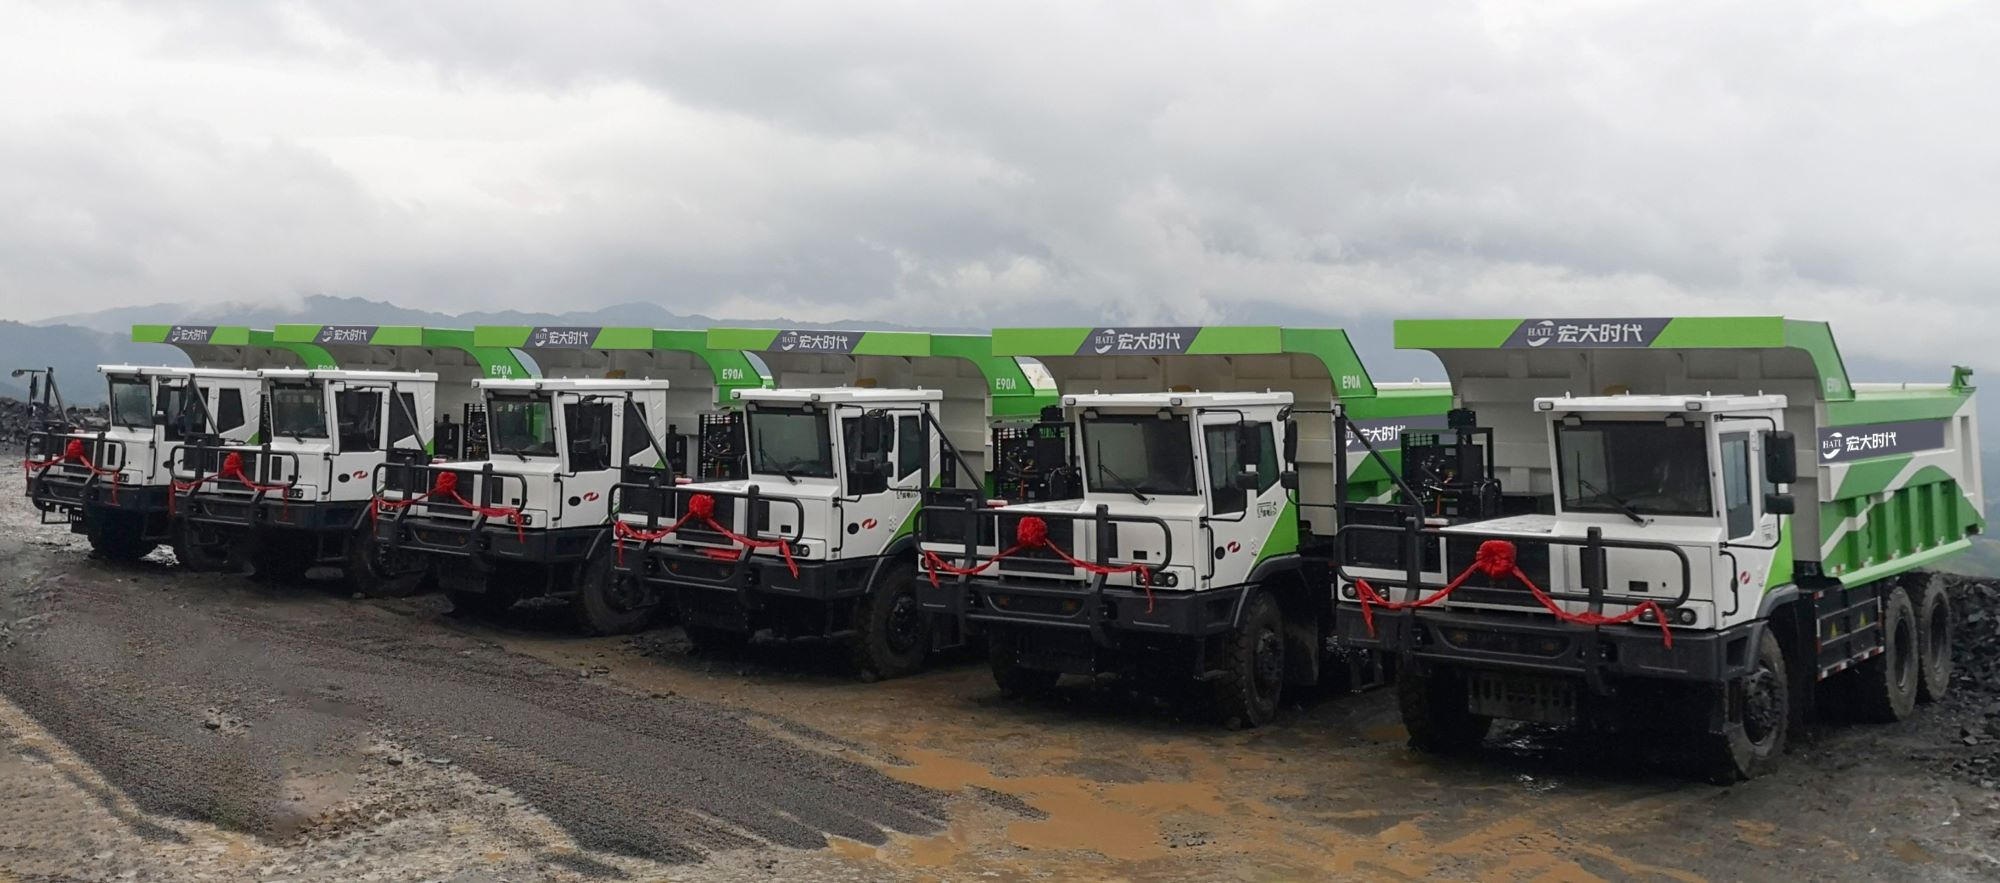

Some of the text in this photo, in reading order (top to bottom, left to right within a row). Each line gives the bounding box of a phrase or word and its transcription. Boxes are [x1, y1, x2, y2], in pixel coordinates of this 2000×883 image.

[334, 329, 367, 341] 宏大时代
[549, 331, 589, 345] 宏大时代
[1527, 324, 1643, 343] HATL 宏大时代
[799, 335, 848, 350] 宏大时代
[1095, 332, 1181, 350] HATL 宏大时代
[491, 365, 512, 375] E90A
[722, 369, 743, 380] E90A
[996, 378, 1016, 390] E90A
[1342, 375, 1361, 389] E90A
[1823, 432, 1897, 452] HATL 宏大时代
